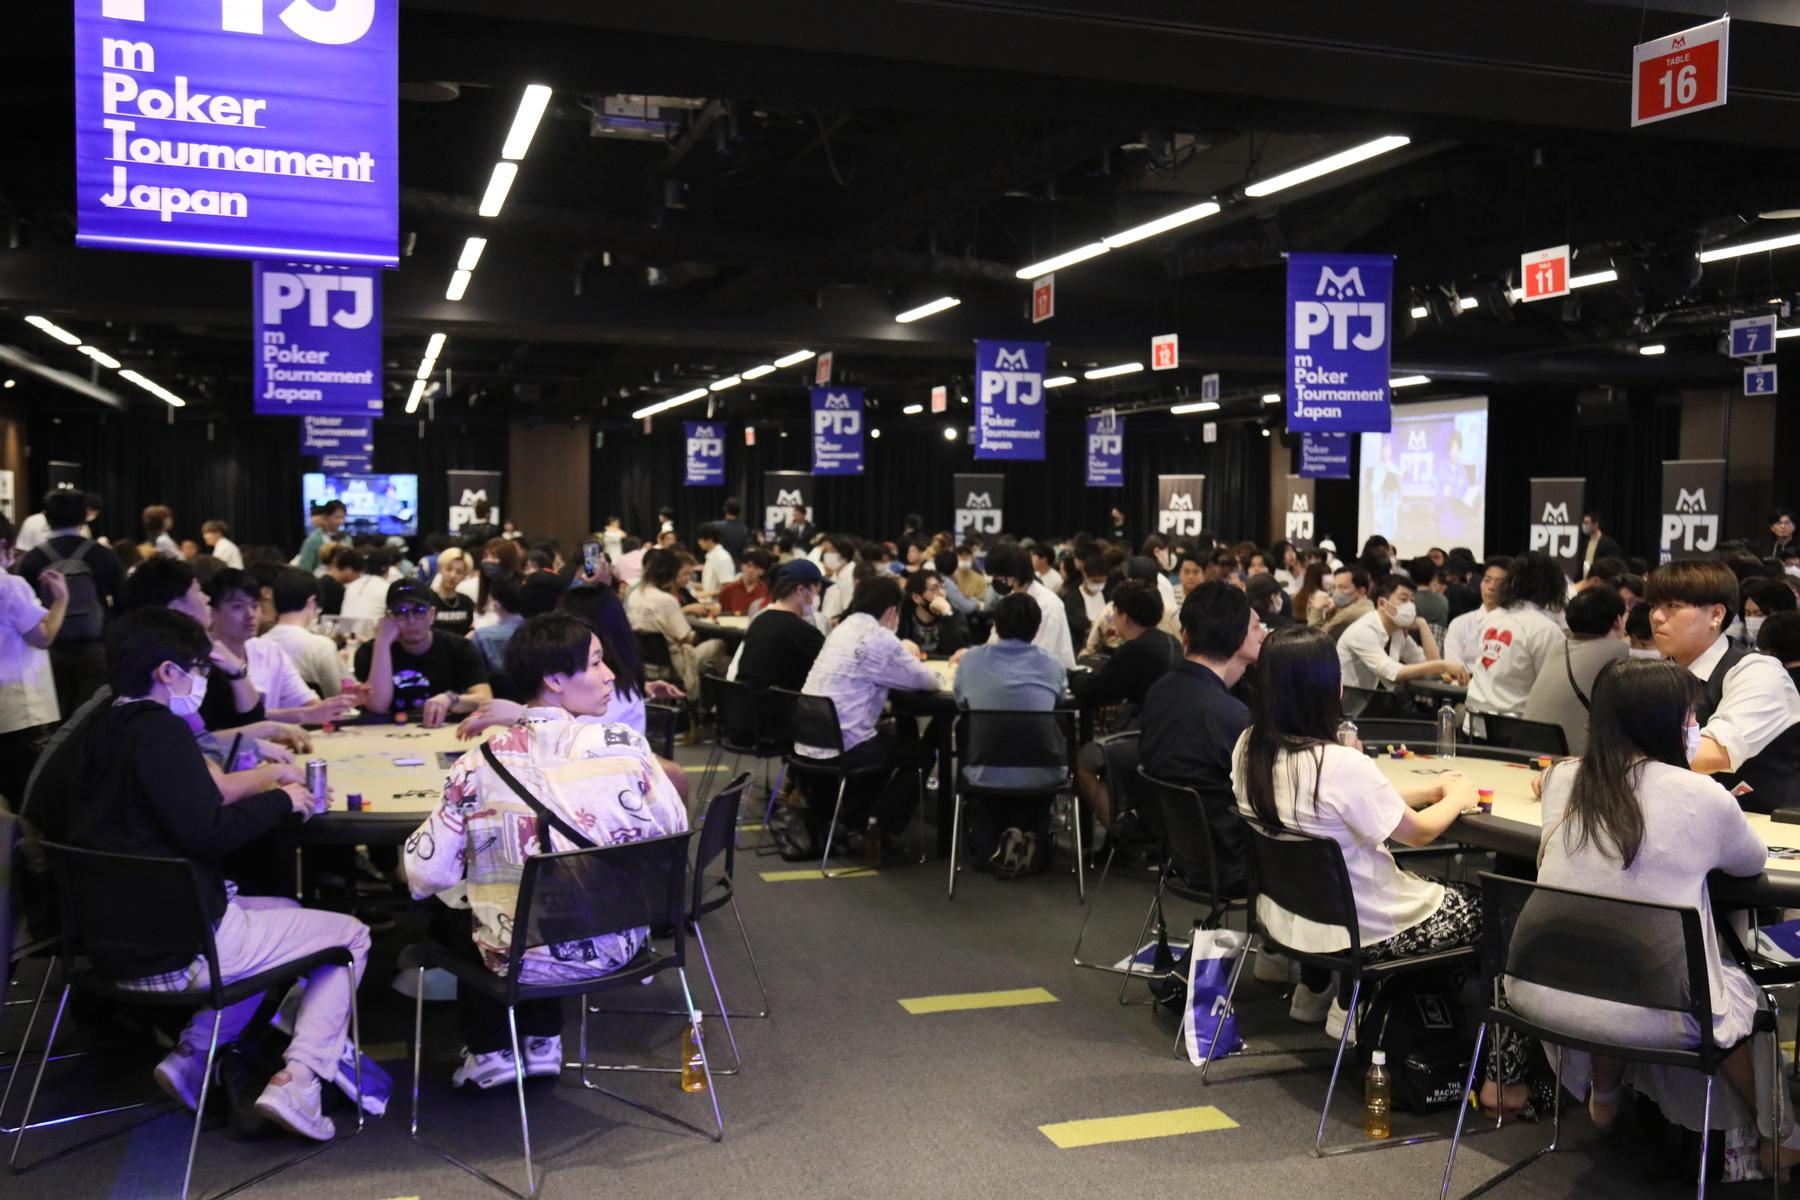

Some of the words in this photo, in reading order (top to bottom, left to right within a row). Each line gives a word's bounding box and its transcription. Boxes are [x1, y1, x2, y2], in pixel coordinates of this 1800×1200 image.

[102, 38, 154, 72] m
[1666, 53, 1690, 67] TABLE
[1659, 64, 1697, 109] 16
[103, 72, 266, 127] Poker
[103, 118, 375, 182] Tournament
[99, 165, 247, 222] Japan
[1535, 269, 1553, 294] 11
[262, 272, 374, 329] PTJ
[1294, 301, 1386, 351] PTJ
[263, 331, 285, 344] m
[1746, 333, 1758, 351] 7
[263, 344, 329, 364] Poker
[1294, 354, 1312, 367] m
[264, 363, 374, 384] Tournament
[1294, 366, 1348, 384] Poker
[262, 382, 323, 404] Japan
[981, 370, 1042, 406] PTJ
[1295, 384, 1384, 402] Tournament
[1756, 377, 1765, 392] 2
[981, 414, 1017, 427] Poker
[1294, 401, 1342, 421] Japan
[814, 409, 860, 435] PTJ
[982, 426, 1040, 439] Tournament
[687, 438, 722, 457] PTJ
[980, 438, 1013, 451] Japan
[1089, 434, 1122, 455] PTJ
[955, 509, 1002, 534] PTJ
[1158, 510, 1202, 536] PTJ
[1285, 512, 1314, 540] PTJ
[1529, 524, 1579, 558] PTJ
[1661, 514, 1719, 552] PTJ
[1434, 1089, 1461, 1097] BACKP
